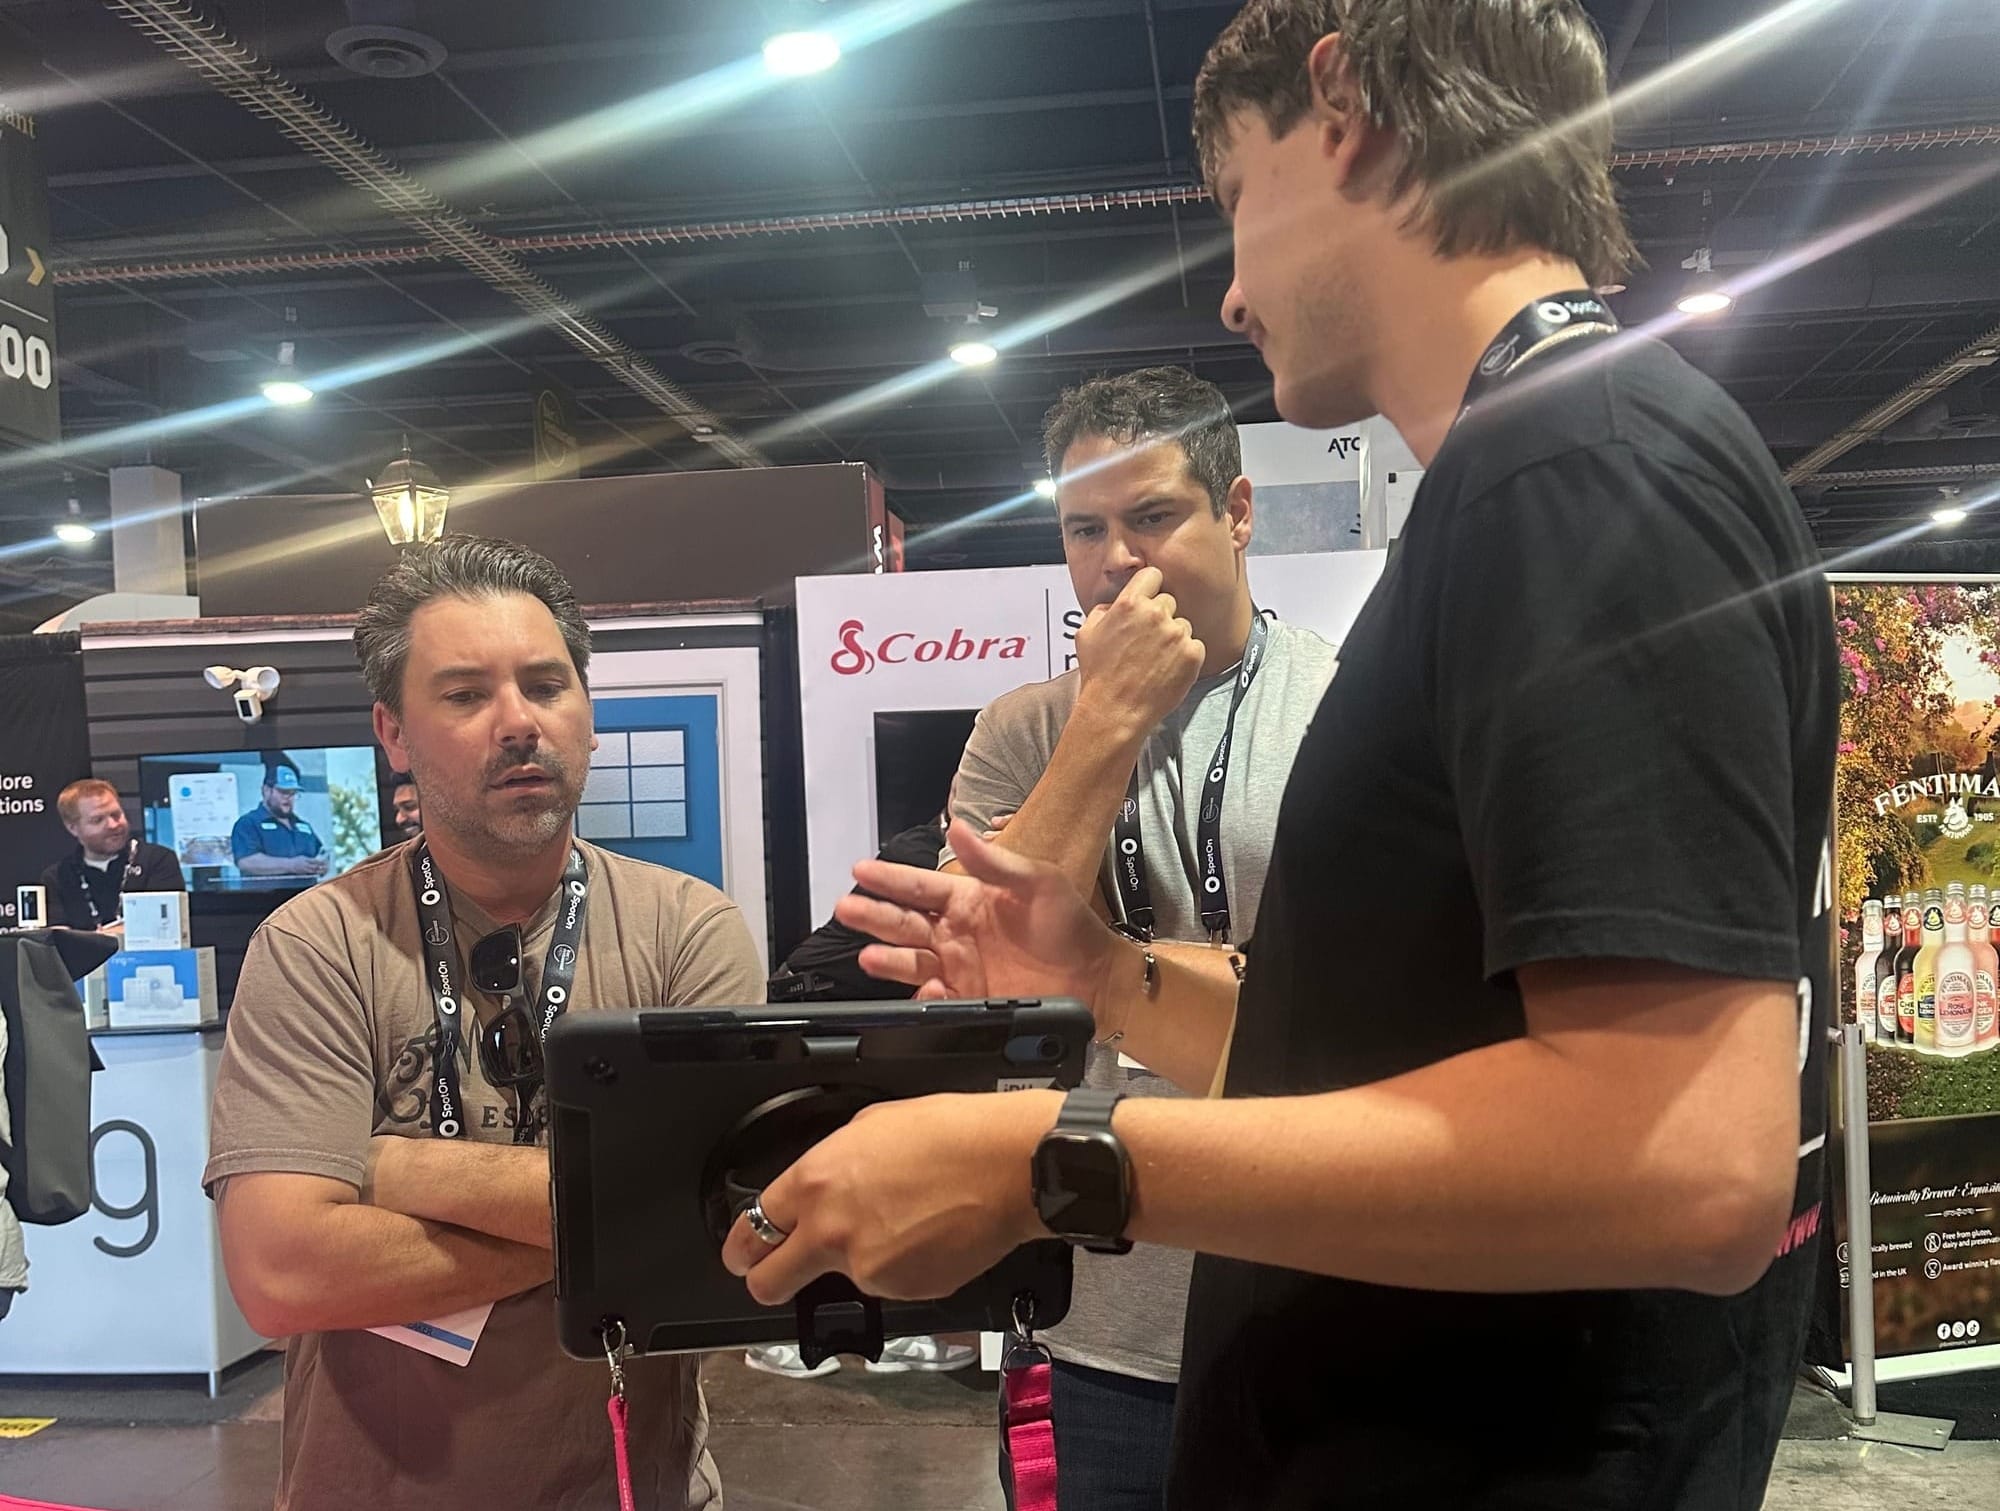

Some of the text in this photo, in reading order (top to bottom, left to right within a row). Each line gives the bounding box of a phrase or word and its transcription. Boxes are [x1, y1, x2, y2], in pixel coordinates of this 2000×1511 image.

[876, 628, 1026, 664] Cobra
[421, 856, 434, 890] SpotOn
[1125, 856, 1139, 891] SpotOn
[1207, 838, 1215, 874] SpotOn
[565, 895, 581, 930] SpotOn
[438, 961, 452, 996] SpotOn
[438, 1078, 453, 1118] SpotOn
[1958, 1239, 1970, 1247] and
